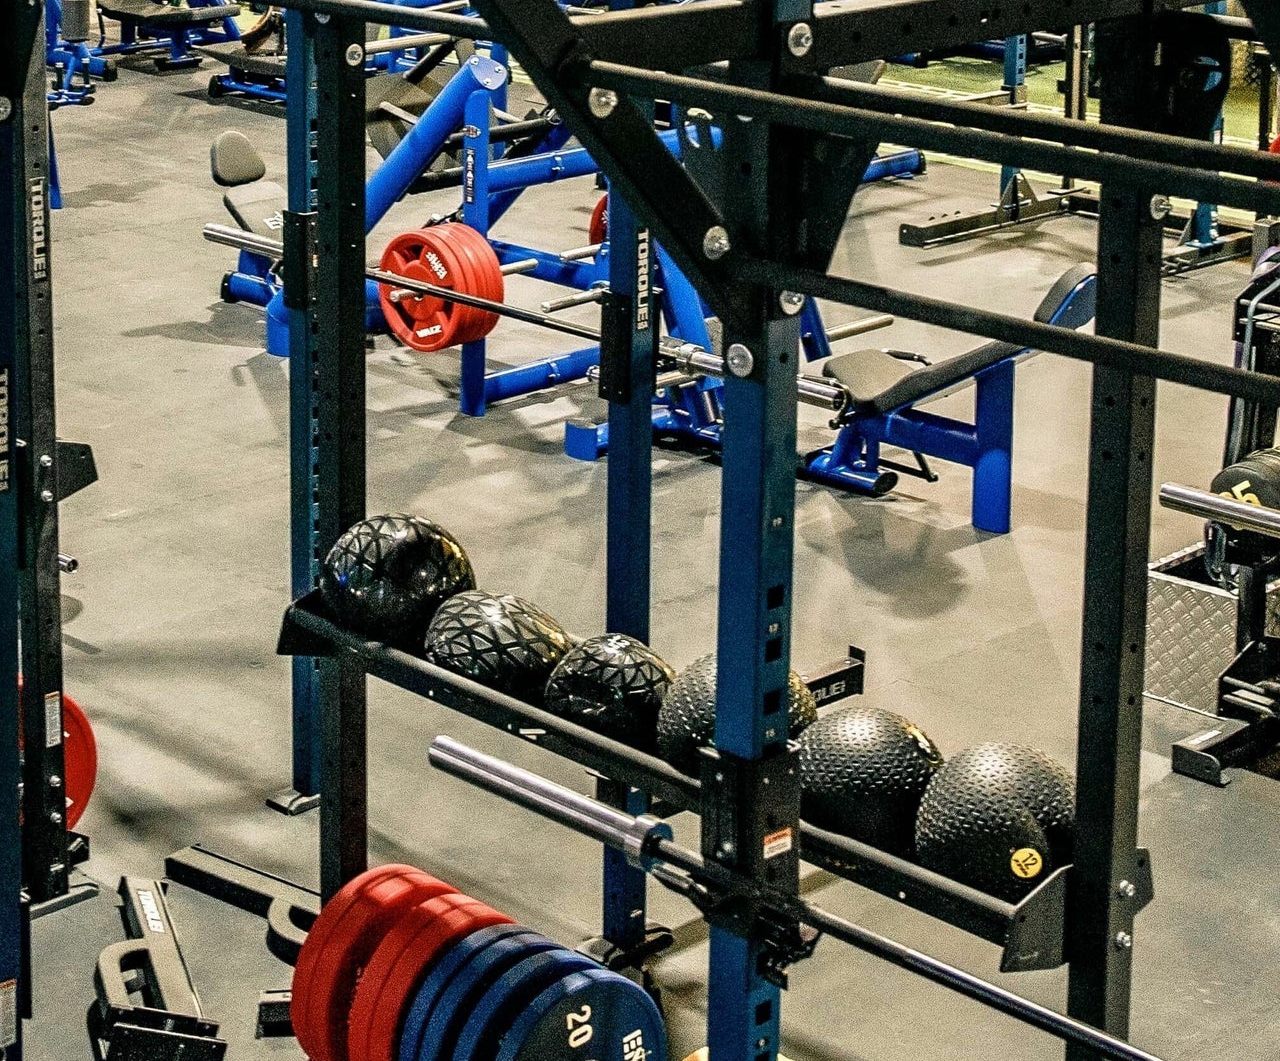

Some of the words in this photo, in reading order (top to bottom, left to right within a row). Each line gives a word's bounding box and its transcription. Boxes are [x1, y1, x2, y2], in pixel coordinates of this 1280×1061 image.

[31, 179, 46, 272] TORQUE
[638, 227, 649, 321] TORQUE
[567, 1004, 593, 1048] 20
